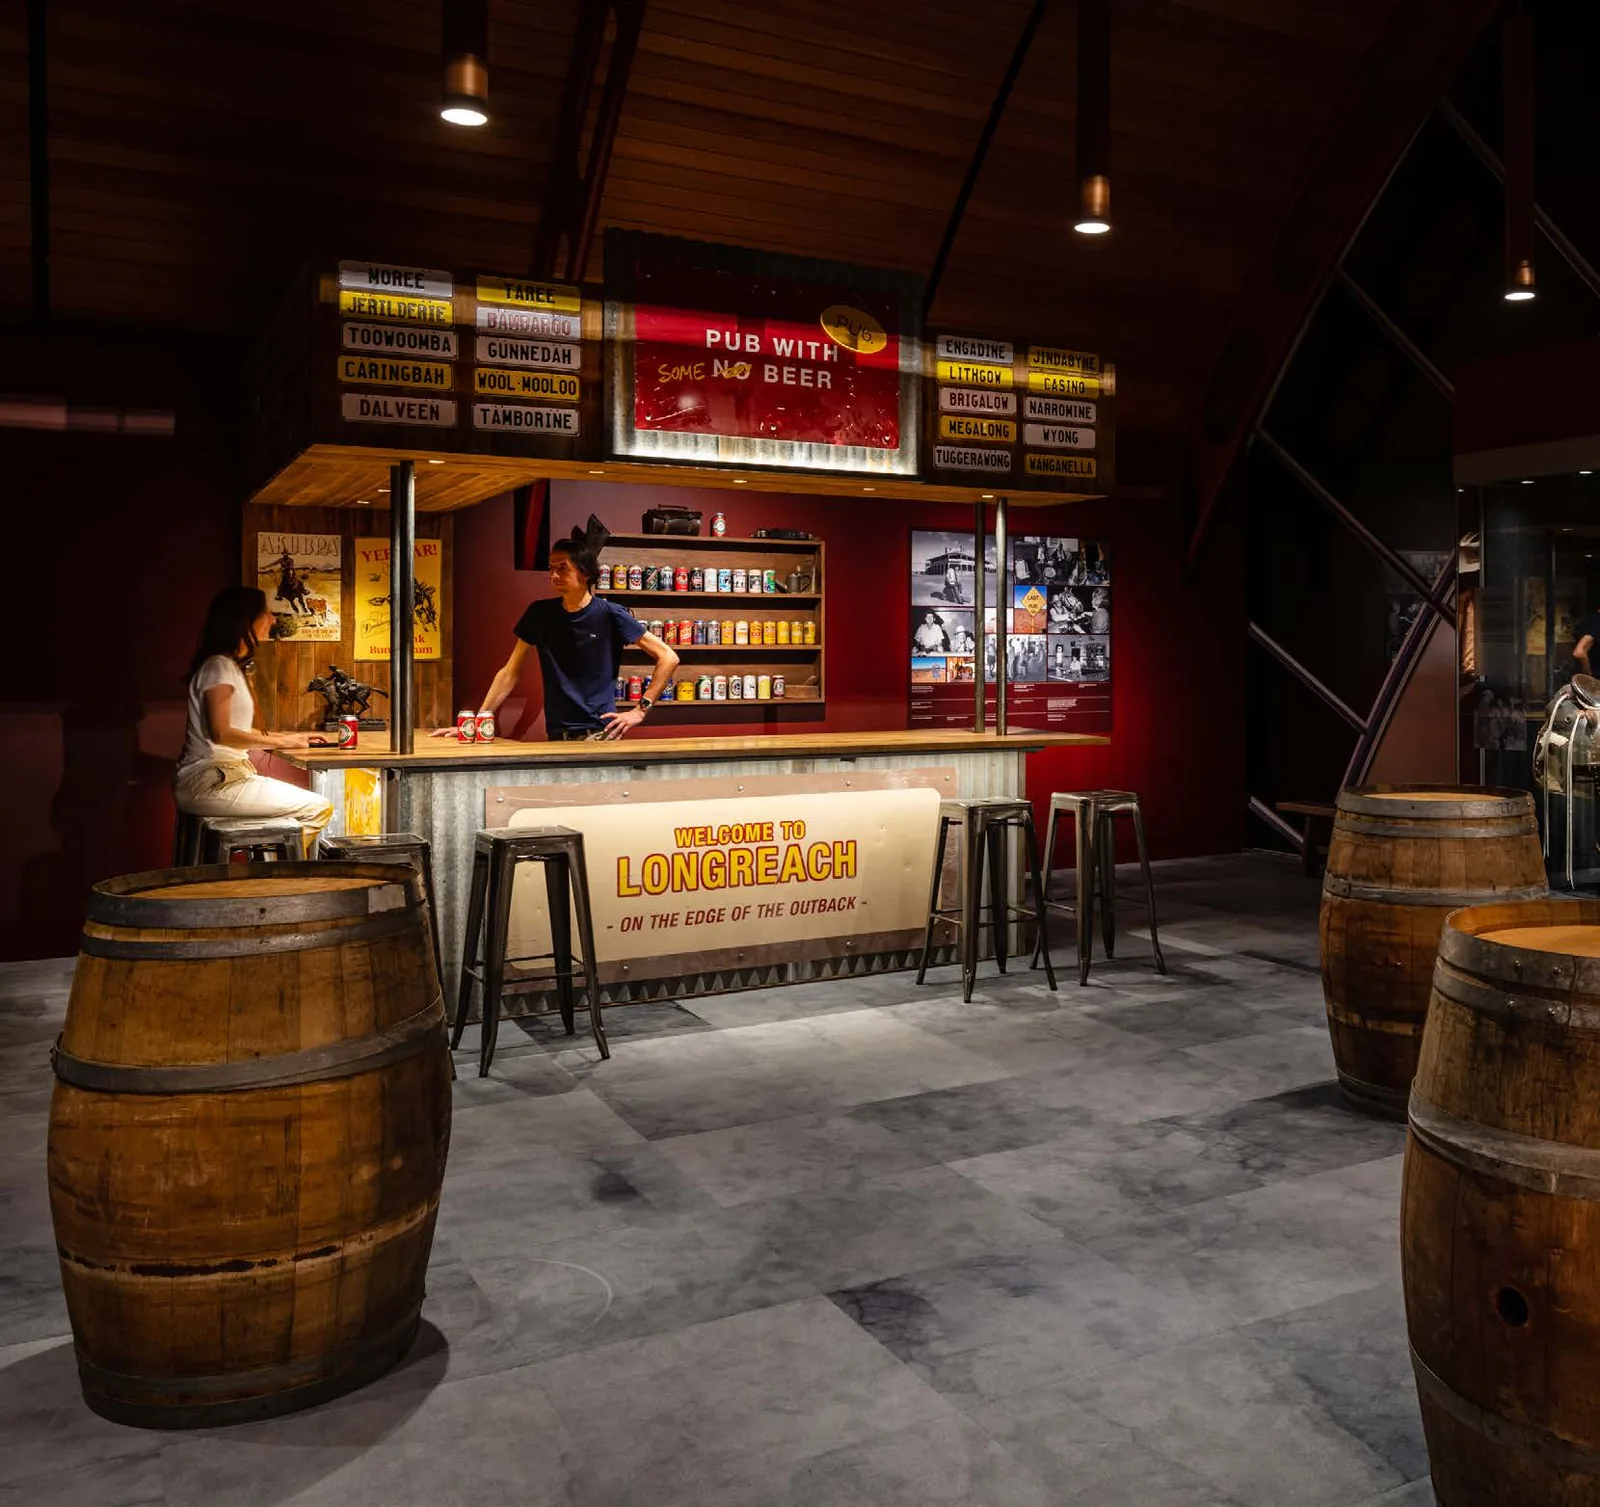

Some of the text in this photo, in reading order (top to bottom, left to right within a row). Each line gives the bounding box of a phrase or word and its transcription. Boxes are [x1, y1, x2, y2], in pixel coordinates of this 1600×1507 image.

[368, 267, 425, 290] MOREE
[504, 283, 556, 304] TAREE
[348, 296, 446, 322] JERILDERIE
[487, 312, 572, 336] BAMBAROO
[347, 327, 451, 352] TOOWOOMBA
[706, 329, 838, 363] PUB WITH
[945, 340, 1005, 359] ENGADINE
[487, 342, 572, 365] GUNNEDAH
[1032, 351, 1096, 371] JINDABYNE
[344, 361, 444, 385] CARINGBAH
[657, 362, 705, 384] SOME
[764, 364, 832, 389] BEER
[949, 366, 1002, 384] LITHGOW
[1044, 377, 1085, 394] CASINO
[359, 399, 440, 421] DALVEEN
[950, 392, 1009, 410] BRIGALOW
[1029, 401, 1092, 420] NARROMINE
[480, 408, 572, 430] TAMBORINE
[949, 418, 1010, 438] MEGALONG
[1042, 428, 1078, 445] WYONG
[936, 449, 1010, 468] TUGGERAWONG
[1029, 457, 1093, 475] WANGANELLA
[260, 535, 339, 556] AKUBRA
[674, 819, 806, 849] WELCOME TO
[616, 839, 858, 898] LONGREACH
[620, 915, 644, 933] ON
[650, 912, 680, 930] THE
[684, 907, 726, 927] EDGE
[731, 905, 751, 921] OF
[757, 902, 785, 919] THE
[789, 896, 857, 916] OUTBACK
